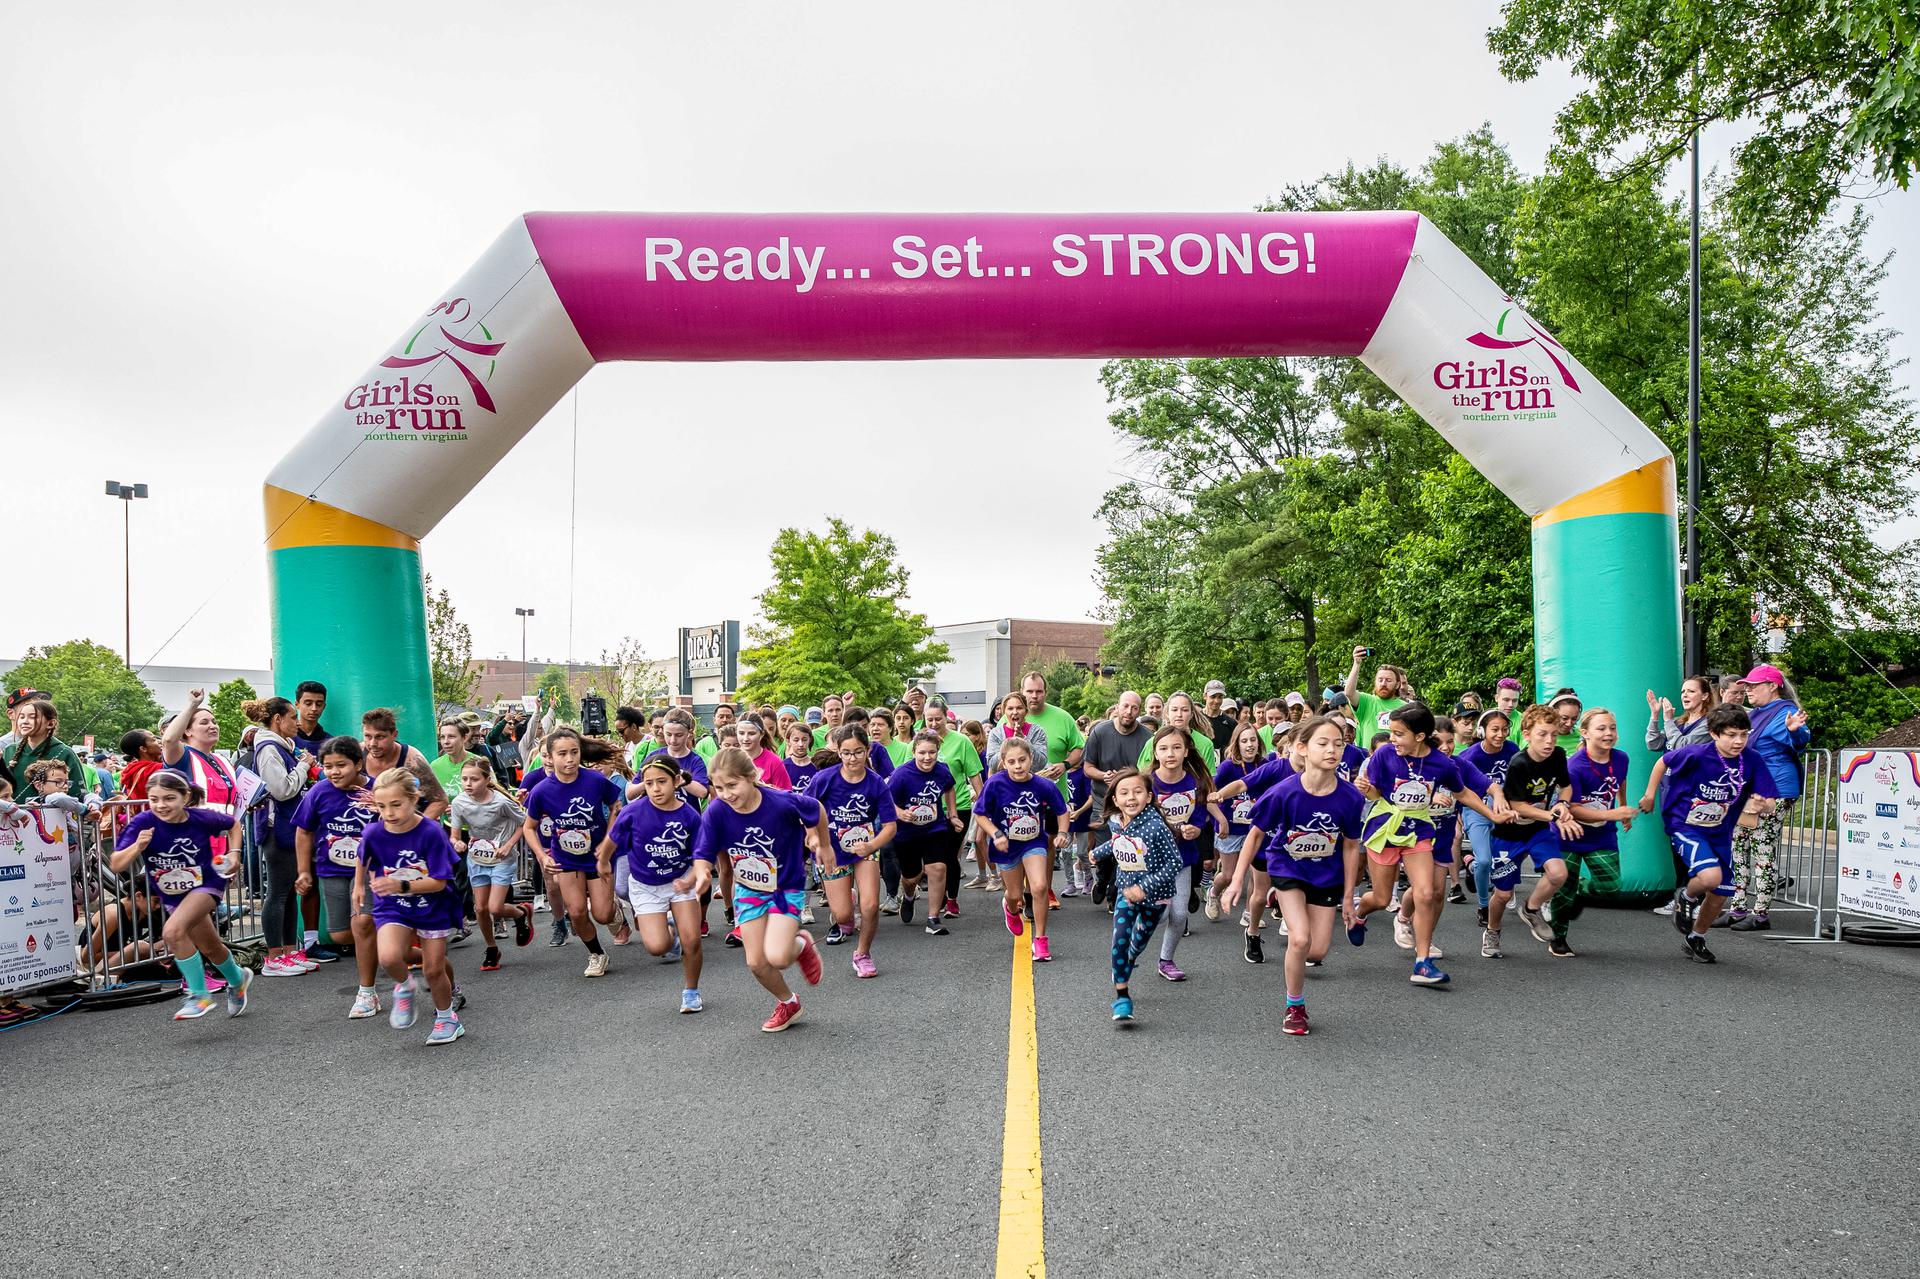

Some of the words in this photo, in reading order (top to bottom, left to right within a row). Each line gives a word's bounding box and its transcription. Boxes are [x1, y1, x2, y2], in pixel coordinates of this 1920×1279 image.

[645, 237, 871, 294] Ready...
[891, 236, 1032, 279] Set...
[1052, 233, 1316, 279] STRONG!
[1433, 359, 1529, 390] Girls
[1530, 376, 1550, 386] on
[344, 377, 434, 411] Girls
[436, 395, 460, 406] on
[1452, 394, 1481, 407] the
[1481, 387, 1555, 411] run
[356, 411, 386, 425] the
[386, 407, 466, 431] run
[1462, 412, 1510, 422] northern
[1513, 410, 1557, 422] virginia
[365, 432, 419, 442] northern
[422, 430, 469, 443] virginia
[1700, 783, 1722, 795] Girls
[1400, 793, 1426, 804] 2792
[1846, 792, 1864, 804] LMI
[1003, 806, 1024, 816] Girls
[1166, 805, 1190, 817] 2807
[1877, 805, 1898, 814] CLARK
[1695, 811, 1723, 822] 2793
[327, 822, 354, 832] Girls
[1015, 826, 1037, 835] 2805
[1853, 831, 1871, 839] UNITED
[563, 841, 586, 850] 1165
[1853, 837, 1866, 845] BANK
[473, 849, 495, 859] 2737
[645, 844, 673, 855] Girls
[728, 848, 756, 858] Girls
[1295, 844, 1327, 853] 2801
[35, 852, 63, 867] Wegmans
[335, 849, 356, 860] 216
[1115, 850, 1137, 863] 2808
[148, 856, 178, 865] Girls
[0, 866, 24, 877] CLARK
[740, 869, 769, 884] 2806
[164, 881, 195, 890] 2183
[1841, 893, 1860, 906] Thank
[1861, 899, 1874, 909] you
[1875, 901, 1883, 910] to
[1884, 904, 1896, 913] our
[7, 974, 16, 984] to
[18, 971, 32, 982] our
[34, 961, 73, 980] sponsors!
